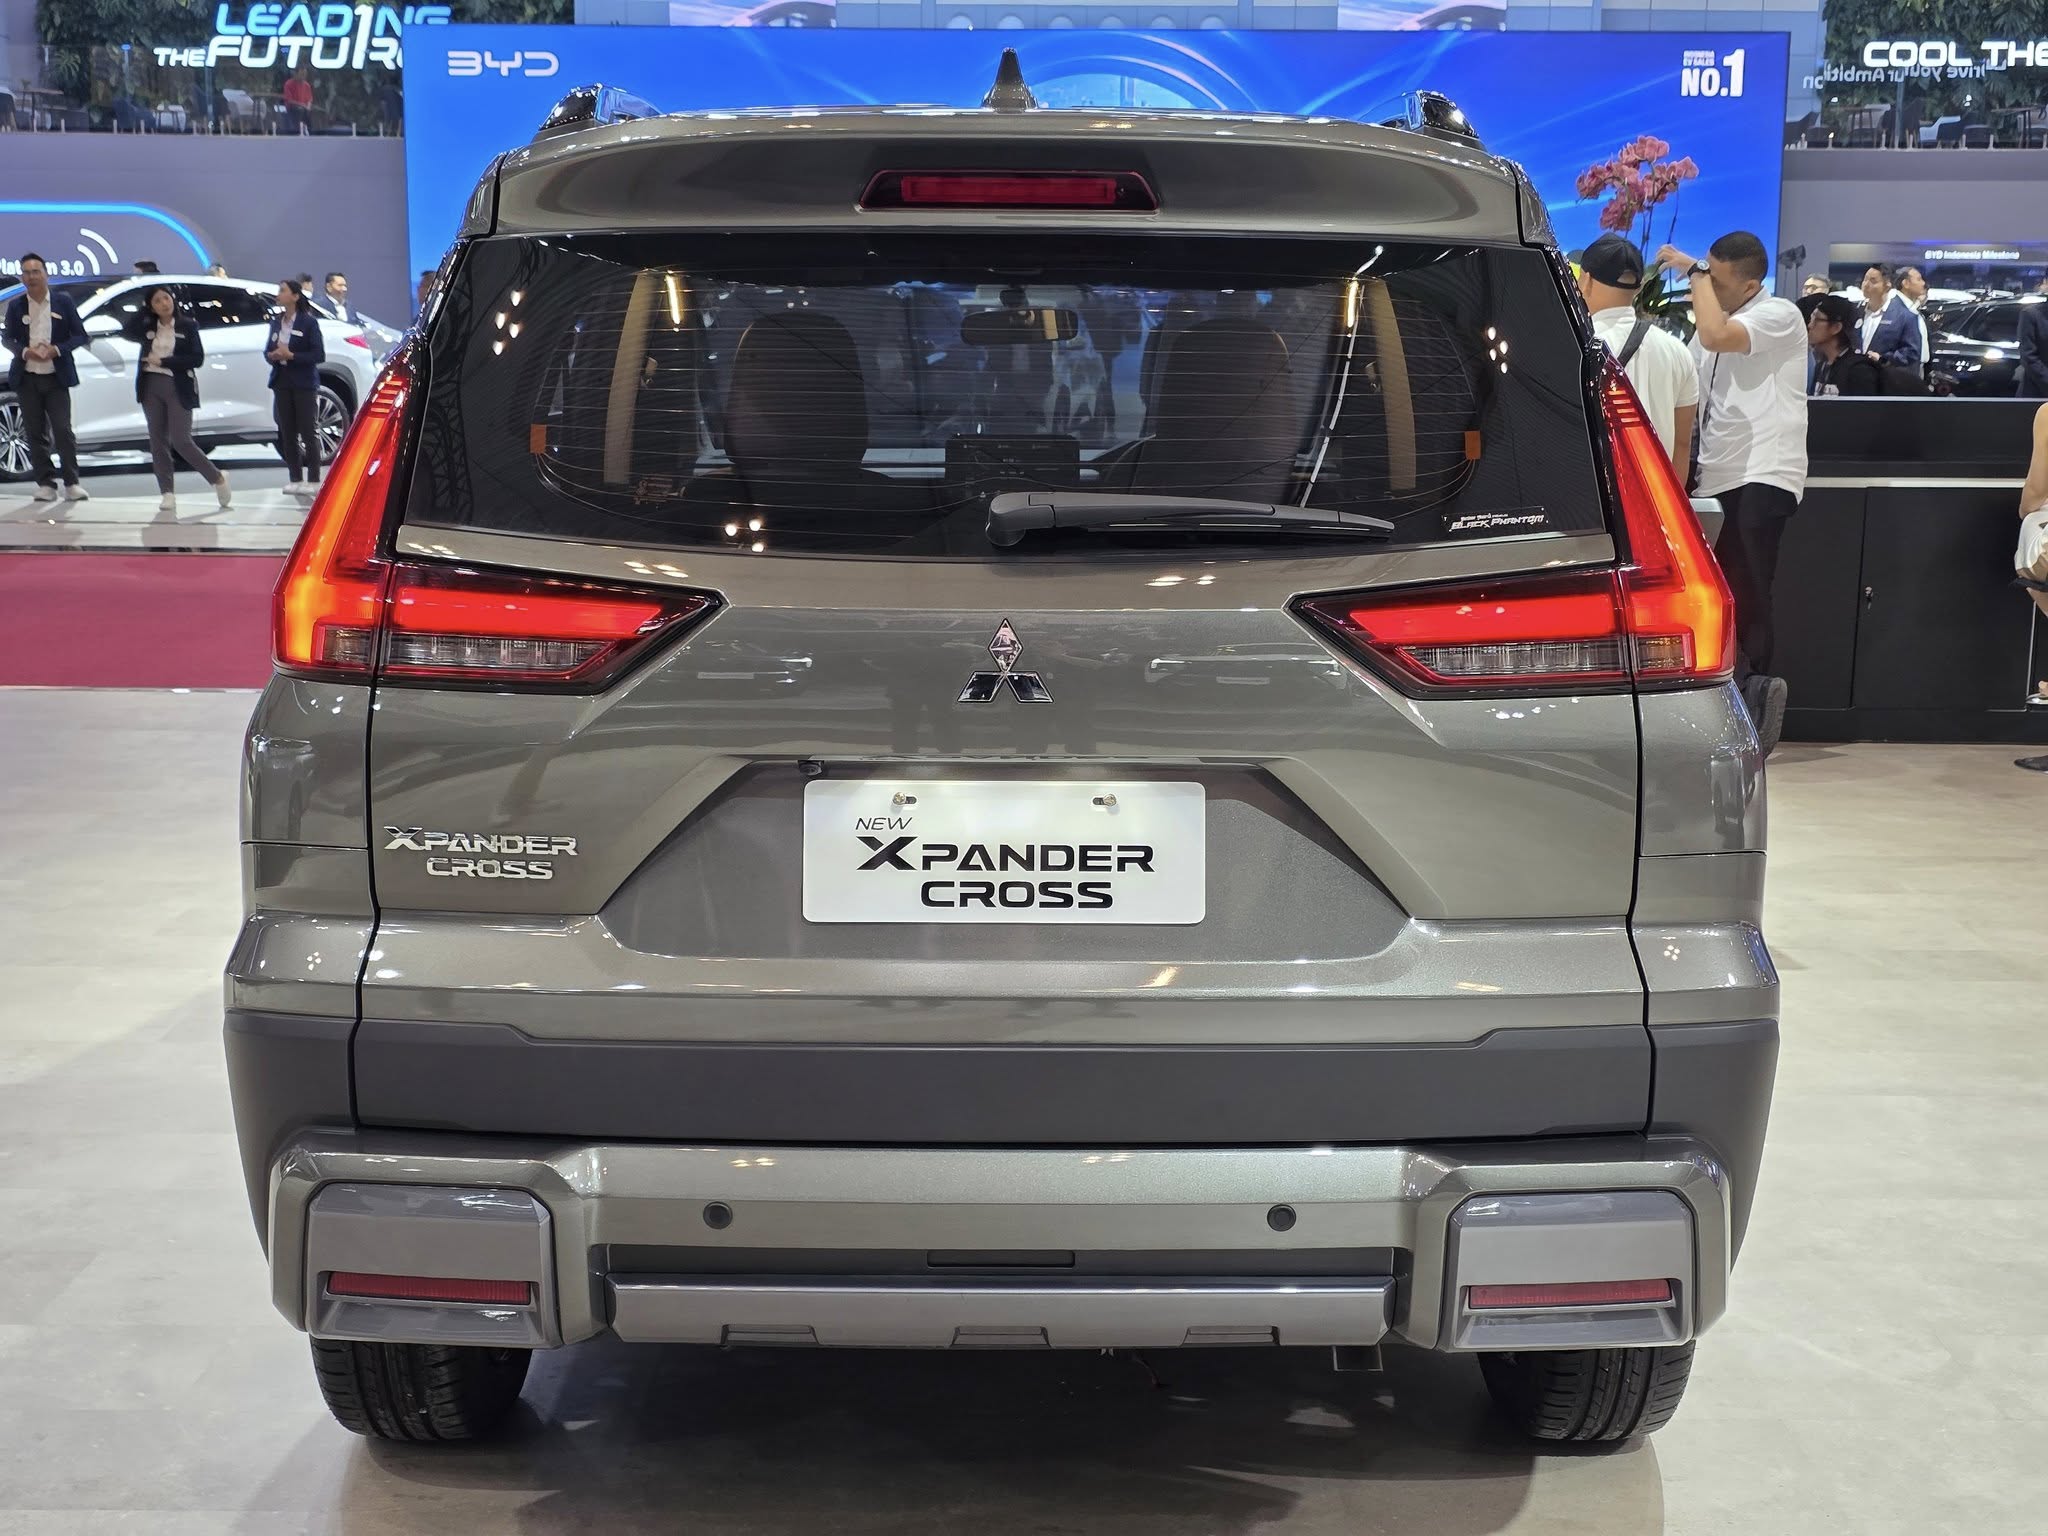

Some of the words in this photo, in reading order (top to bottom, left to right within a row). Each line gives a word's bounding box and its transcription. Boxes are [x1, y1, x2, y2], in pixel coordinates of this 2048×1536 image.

[153, 47, 206, 67] THE
[205, 35, 403, 70] FUTUR
[447, 50, 560, 77] BYD
[1863, 41, 1973, 68] COOL
[60, 259, 85, 276] 3.0
[855, 817, 912, 831] NEW
[384, 826, 579, 856] XPANDER
[856, 836, 1155, 872] XPANDER
[426, 857, 553, 880] CROSS
[920, 880, 1114, 908] CROSS
